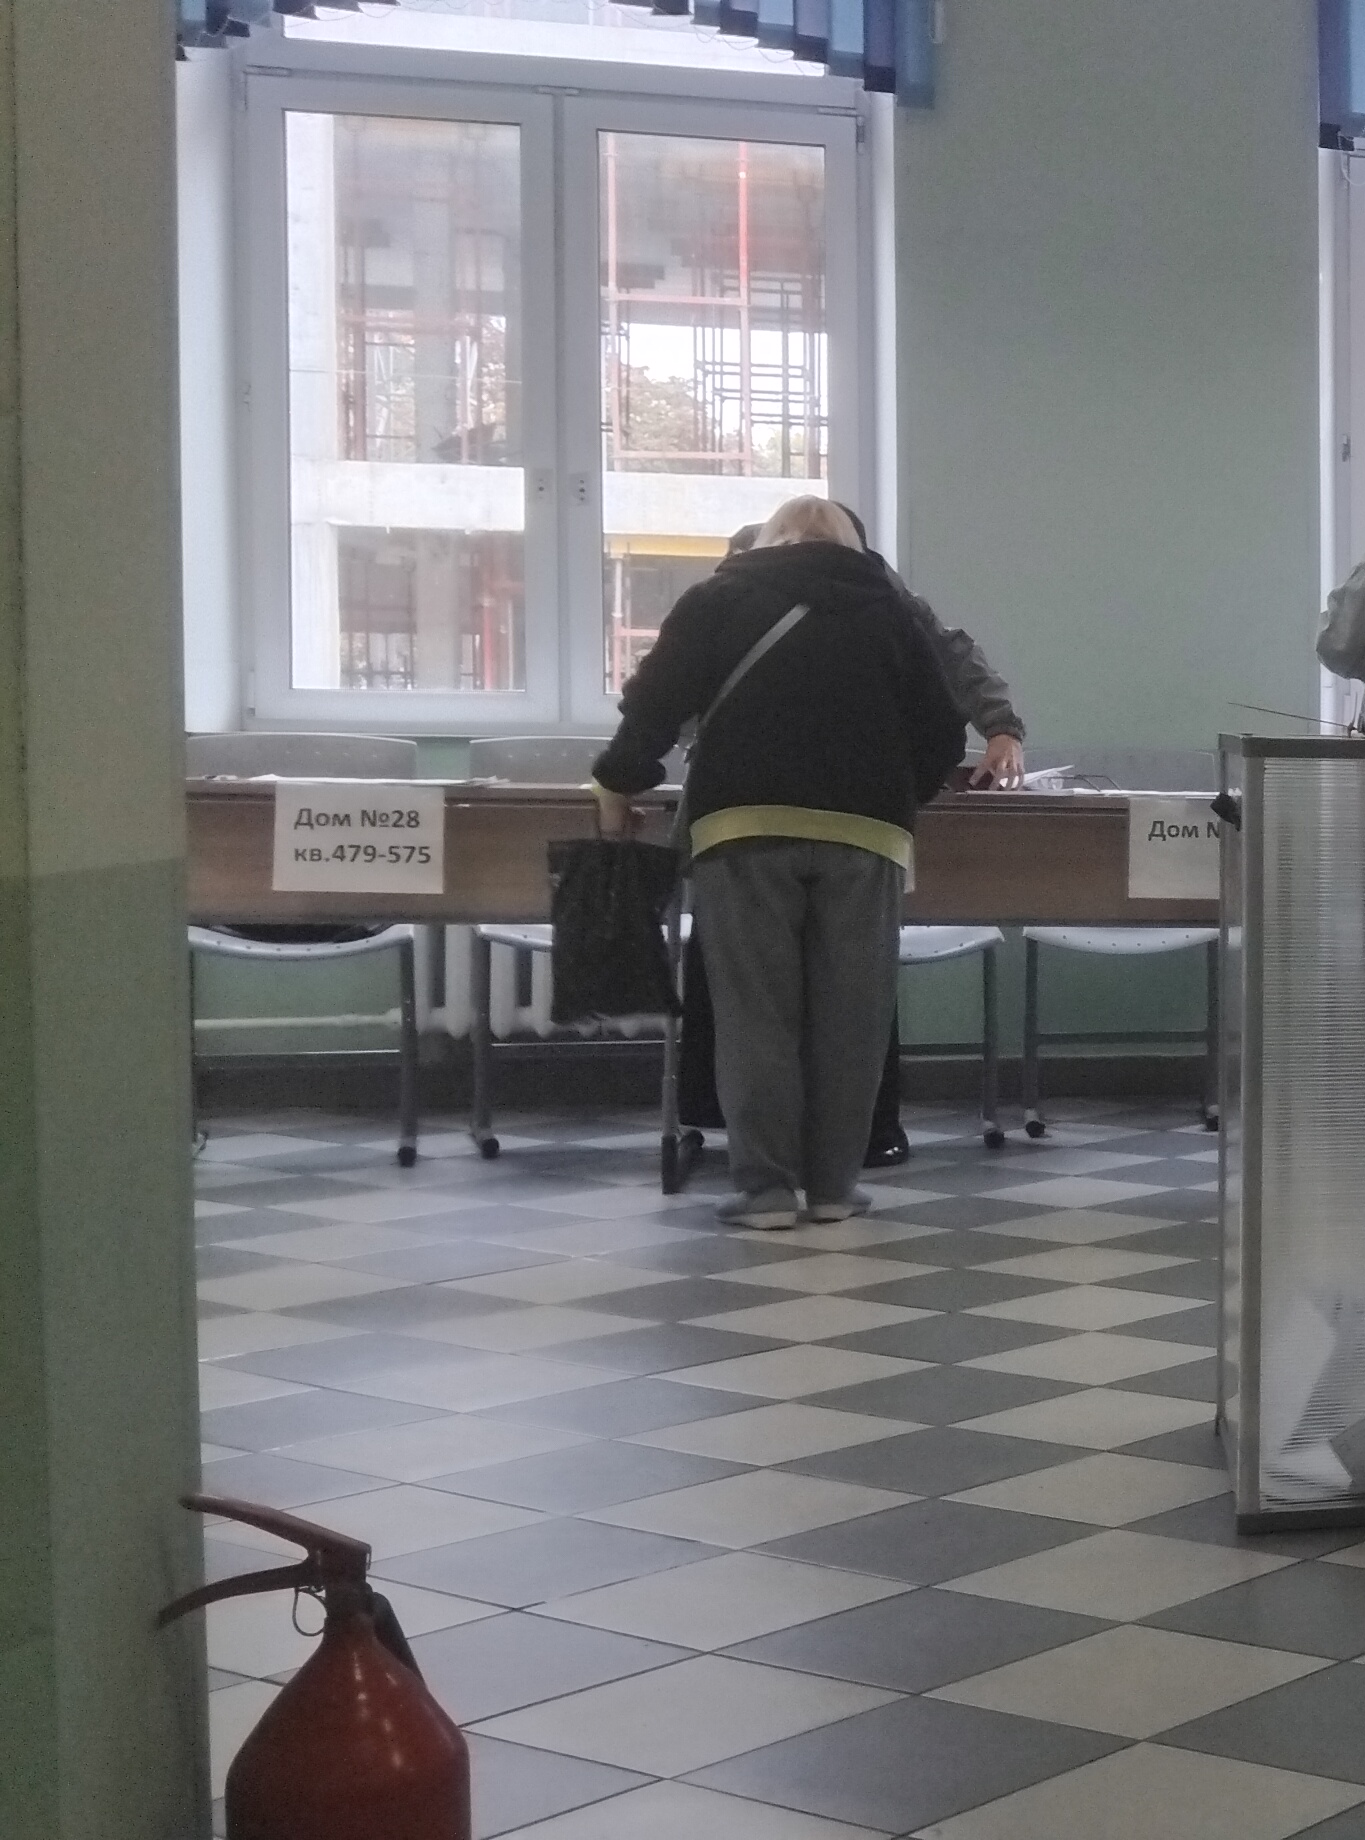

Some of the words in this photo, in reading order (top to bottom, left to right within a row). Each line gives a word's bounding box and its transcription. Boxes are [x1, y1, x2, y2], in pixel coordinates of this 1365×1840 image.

[294, 808, 351, 830] Дом
[360, 809, 420, 829] №28
[1148, 820, 1199, 841] Дом
[294, 844, 432, 864] кв.479-575
